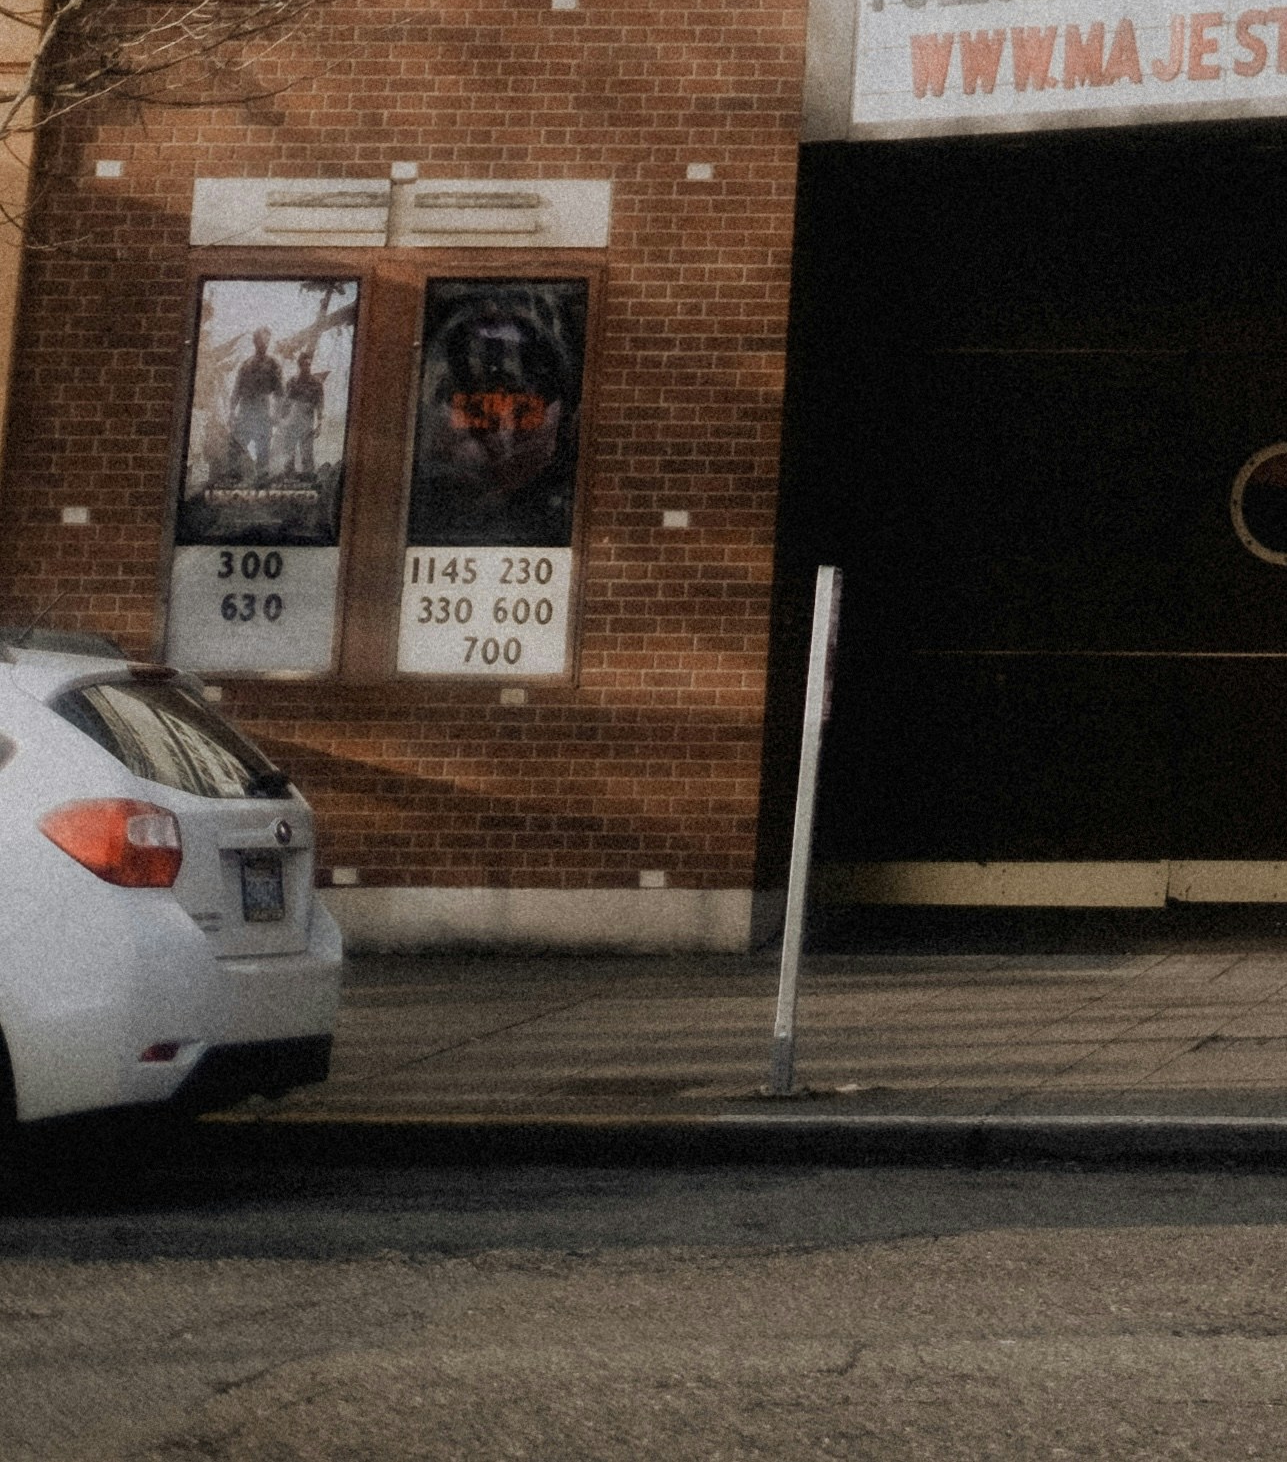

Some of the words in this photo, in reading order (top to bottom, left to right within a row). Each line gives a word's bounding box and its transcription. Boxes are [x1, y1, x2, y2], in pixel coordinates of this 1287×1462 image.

[217, 551, 283, 580] 300
[411, 557, 478, 585] 1145
[499, 557, 553, 585] 230
[220, 593, 283, 622] 630
[417, 596, 473, 624] 330
[492, 597, 553, 625] 600
[463, 637, 522, 665] 700
